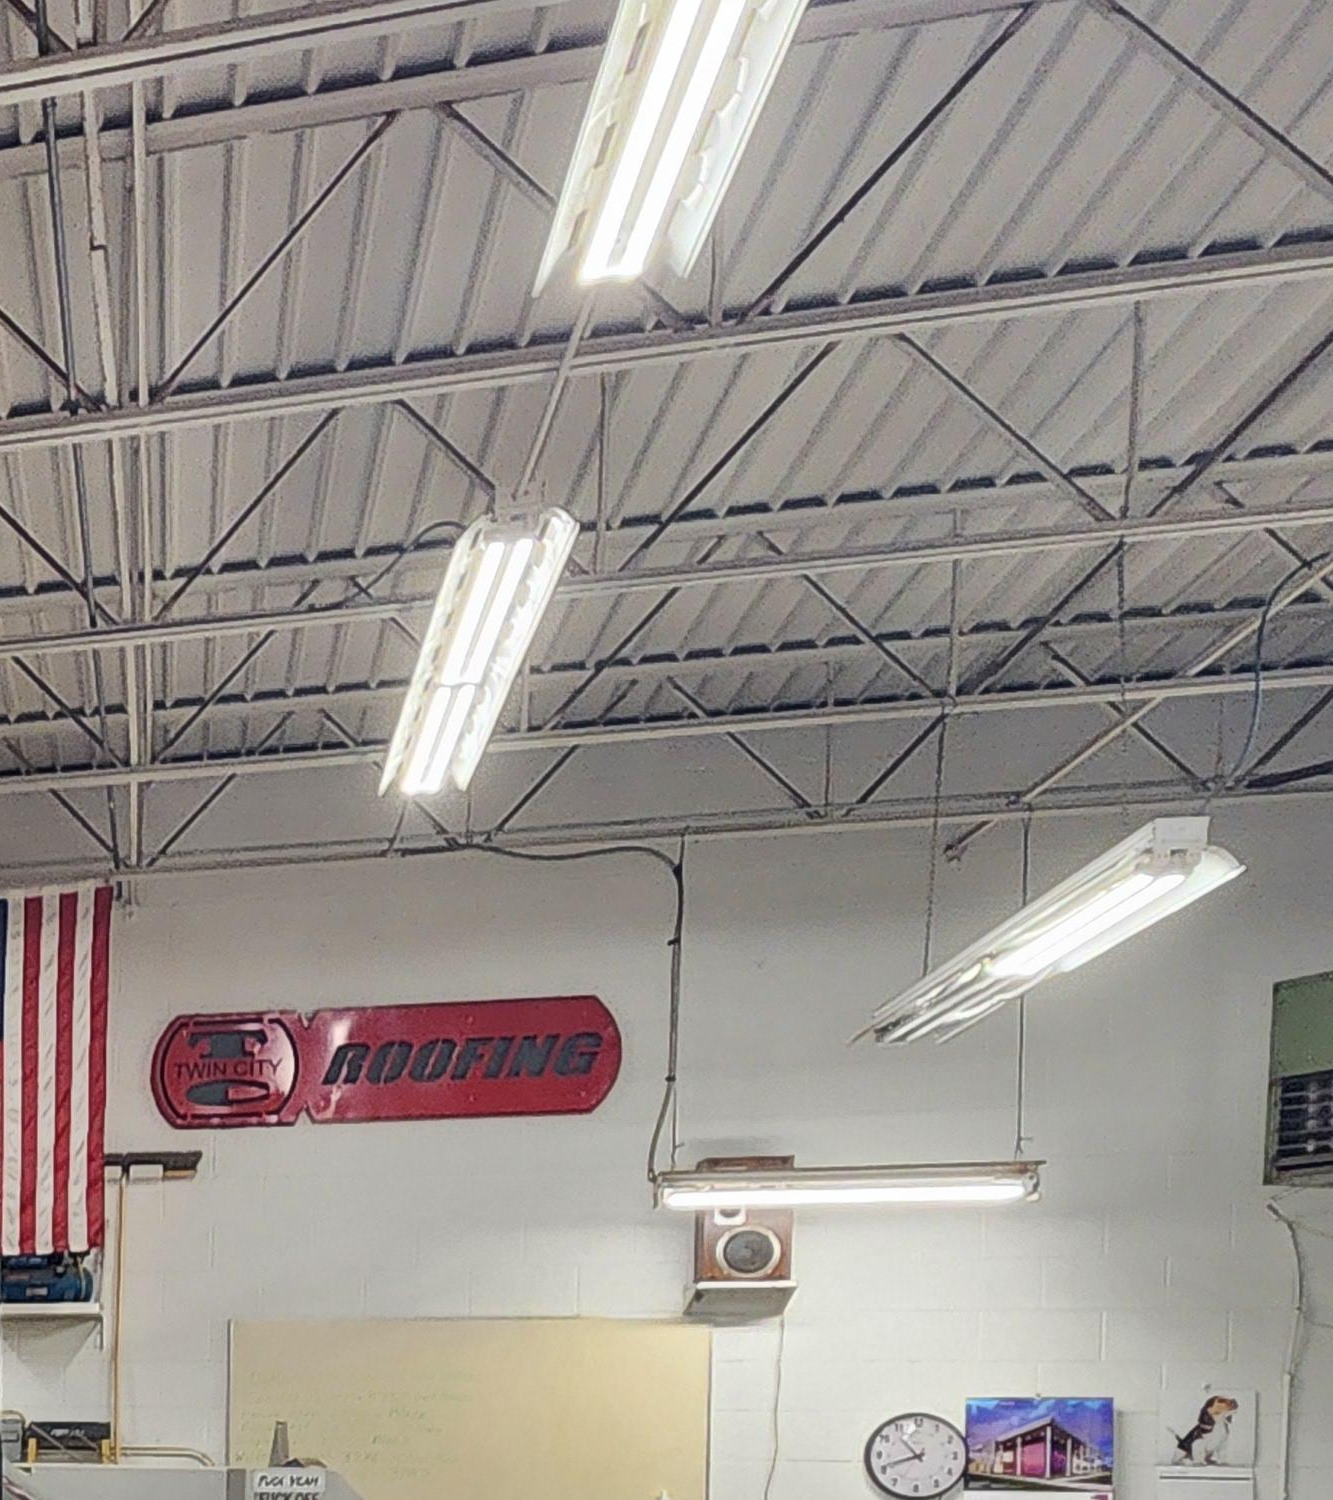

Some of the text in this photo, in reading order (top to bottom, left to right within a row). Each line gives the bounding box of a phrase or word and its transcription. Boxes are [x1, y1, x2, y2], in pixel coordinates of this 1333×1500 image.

[175, 1057, 283, 1079] TWIN CITY
[321, 1032, 604, 1086] ROOFING
